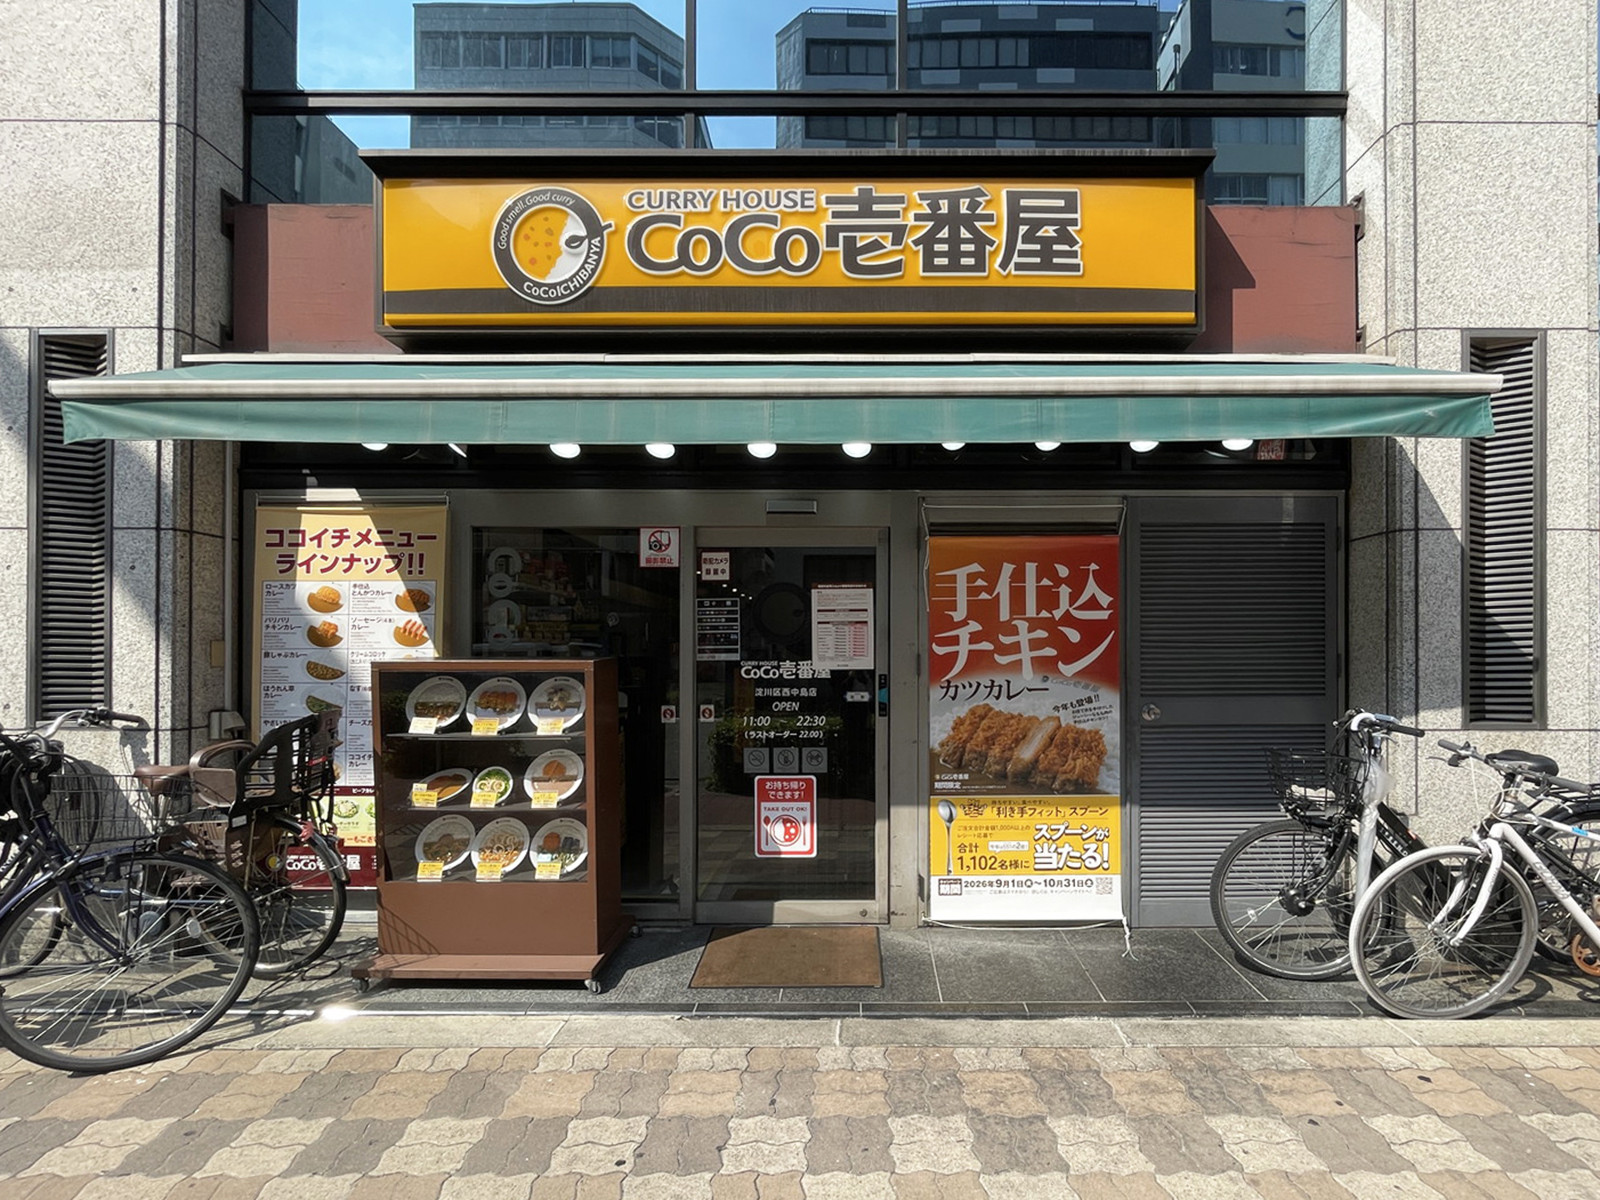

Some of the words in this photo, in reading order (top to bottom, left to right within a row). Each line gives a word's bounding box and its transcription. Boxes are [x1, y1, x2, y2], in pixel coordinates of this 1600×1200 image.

[627, 190, 717, 211] CURRY
[720, 190, 816, 210] HOUSE
[497, 222, 510, 250] Good
[551, 193, 576, 207] curry
[626, 187, 1083, 277] CoCo壱番屋
[265, 528, 437, 548] ココイチメニュー
[276, 552, 425, 575] ラインナップ!!
[931, 561, 1114, 622] 手仕込
[931, 619, 1115, 681] チキン
[755, 688, 818, 697] 淀川区西中島店
[939, 679, 1050, 701] カツカレー
[772, 701, 800, 712] OPEN
[742, 716, 771, 727] 11:00
[796, 715, 826, 727] 22:30
[765, 781, 807, 790] お持ち帰り
[768, 791, 805, 799] できます!
[990, 805, 1067, 818] 「利き手フィット」
[1068, 806, 1109, 817] スプーン
[1033, 821, 1110, 841] スプーンが
[957, 843, 979, 853] 合計
[1033, 841, 1110, 871] 当たる!
[957, 855, 1030, 872] 1,102名様に
